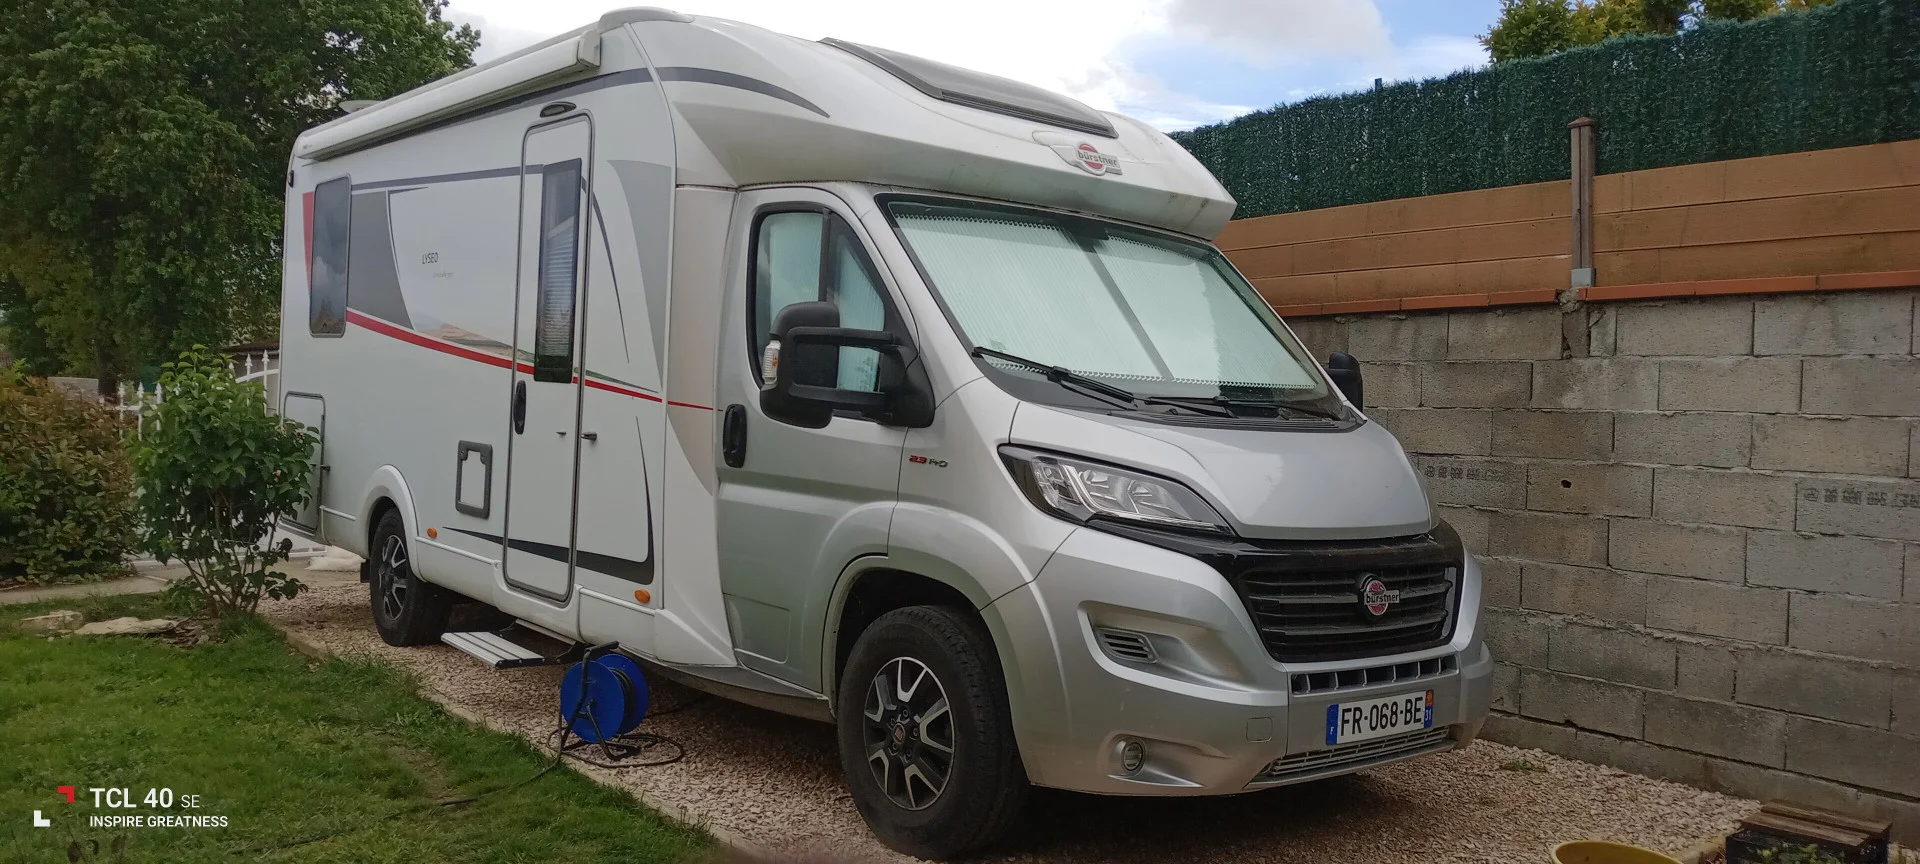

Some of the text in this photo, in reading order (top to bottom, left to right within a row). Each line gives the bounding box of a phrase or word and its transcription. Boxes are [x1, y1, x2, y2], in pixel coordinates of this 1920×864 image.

[1077, 149, 1117, 166] bürstner
[422, 252, 439, 264] LYSEO
[1366, 593, 1399, 604] bürstner
